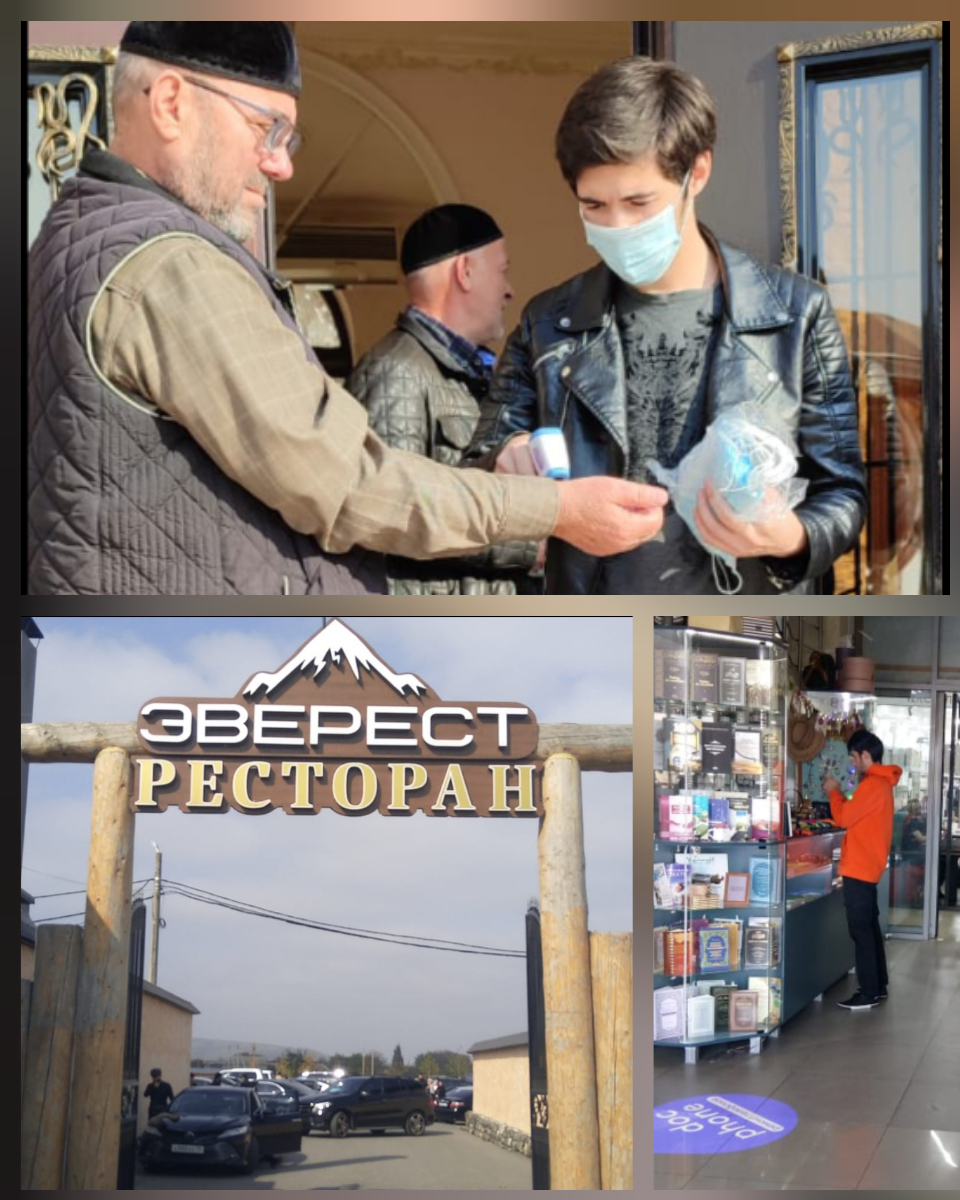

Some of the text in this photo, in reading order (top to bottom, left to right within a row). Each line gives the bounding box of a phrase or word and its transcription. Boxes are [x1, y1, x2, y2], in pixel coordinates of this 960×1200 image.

[139, 701, 530, 750] ЭВЕРЕСТ
[135, 758, 538, 812] РЕСТОРАН
[656, 1109, 704, 1133] doc
[682, 1102, 767, 1140] phone
